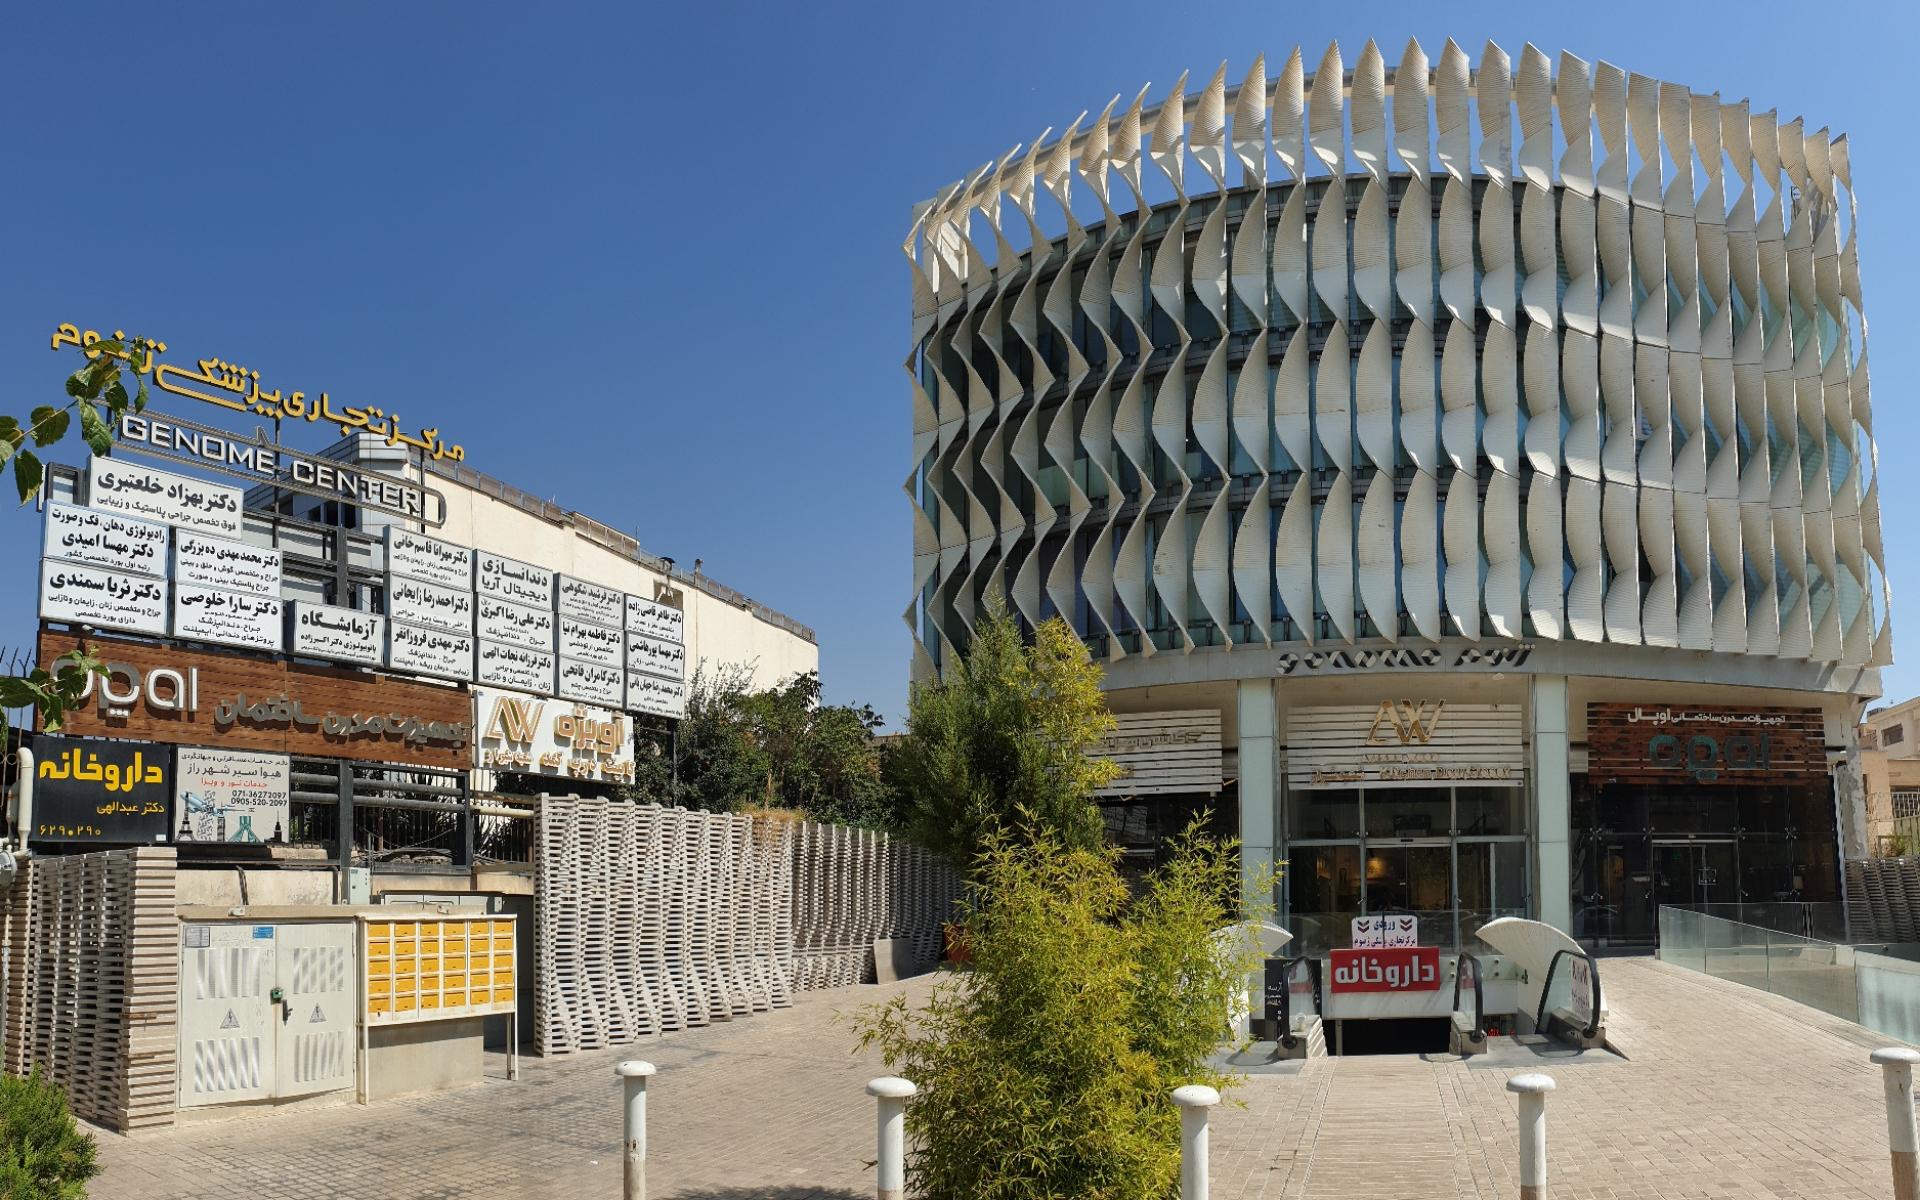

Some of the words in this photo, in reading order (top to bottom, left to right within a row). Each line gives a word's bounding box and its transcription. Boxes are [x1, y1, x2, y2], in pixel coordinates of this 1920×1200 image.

[154, 357, 284, 420] پزشکی
[283, 391, 387, 437] تجاری
[385, 414, 465, 462] مرکز
[122, 414, 275, 474] GENOME
[291, 460, 422, 514] CENTER
[98, 472, 163, 494] خلعتبری
[97, 496, 123, 508] زیبایی
[167, 484, 203, 508] بهزاد
[204, 491, 237, 513] دکتر
[52, 509, 77, 523] صورت
[131, 501, 166, 518] پلاستیک
[168, 509, 191, 522] جراحی
[85, 515, 98, 525] فک
[221, 521, 236, 531] فوق
[62, 533, 99, 549] امیدی
[126, 526, 164, 543] رادیولوژی
[103, 535, 128, 555] مهسا
[129, 543, 154, 558] دکتر
[217, 549, 239, 561] مهدی
[241, 552, 261, 564] محمد
[262, 556, 279, 568] دکتر
[452, 551, 467, 564] دکتر
[483, 560, 547, 586] دندانسازی
[50, 573, 104, 590] سمندی
[107, 576, 130, 599] ثریا
[482, 575, 501, 590] آریا
[130, 584, 161, 601] دکتر
[424, 588, 434, 608] رضا
[504, 582, 547, 602] دیجیتال
[181, 593, 225, 609] خلوصی
[229, 595, 251, 612] سارا
[436, 595, 454, 606] احمد
[453, 598, 468, 613] دکتر
[253, 601, 278, 616] دکتر
[481, 606, 504, 619] اکبری
[506, 607, 517, 624] رضا
[302, 610, 377, 640] آزمایشگاه
[519, 613, 534, 626] علی
[534, 617, 550, 629] دکتر
[330, 638, 342, 646] دکتر
[428, 638, 452, 650] مهدی
[452, 640, 469, 653] دکتر
[606, 633, 620, 645] دکتر
[537, 657, 550, 669] دکتر
[606, 672, 620, 686] دکتر
[1627, 707, 1671, 726] اوپال
[1649, 733, 1769, 781] opal
[39, 748, 163, 792] داروخانه
[96, 801, 139, 815] عبدالهی
[140, 802, 165, 815] دکتر
[1335, 955, 1434, 987] داروخانه
